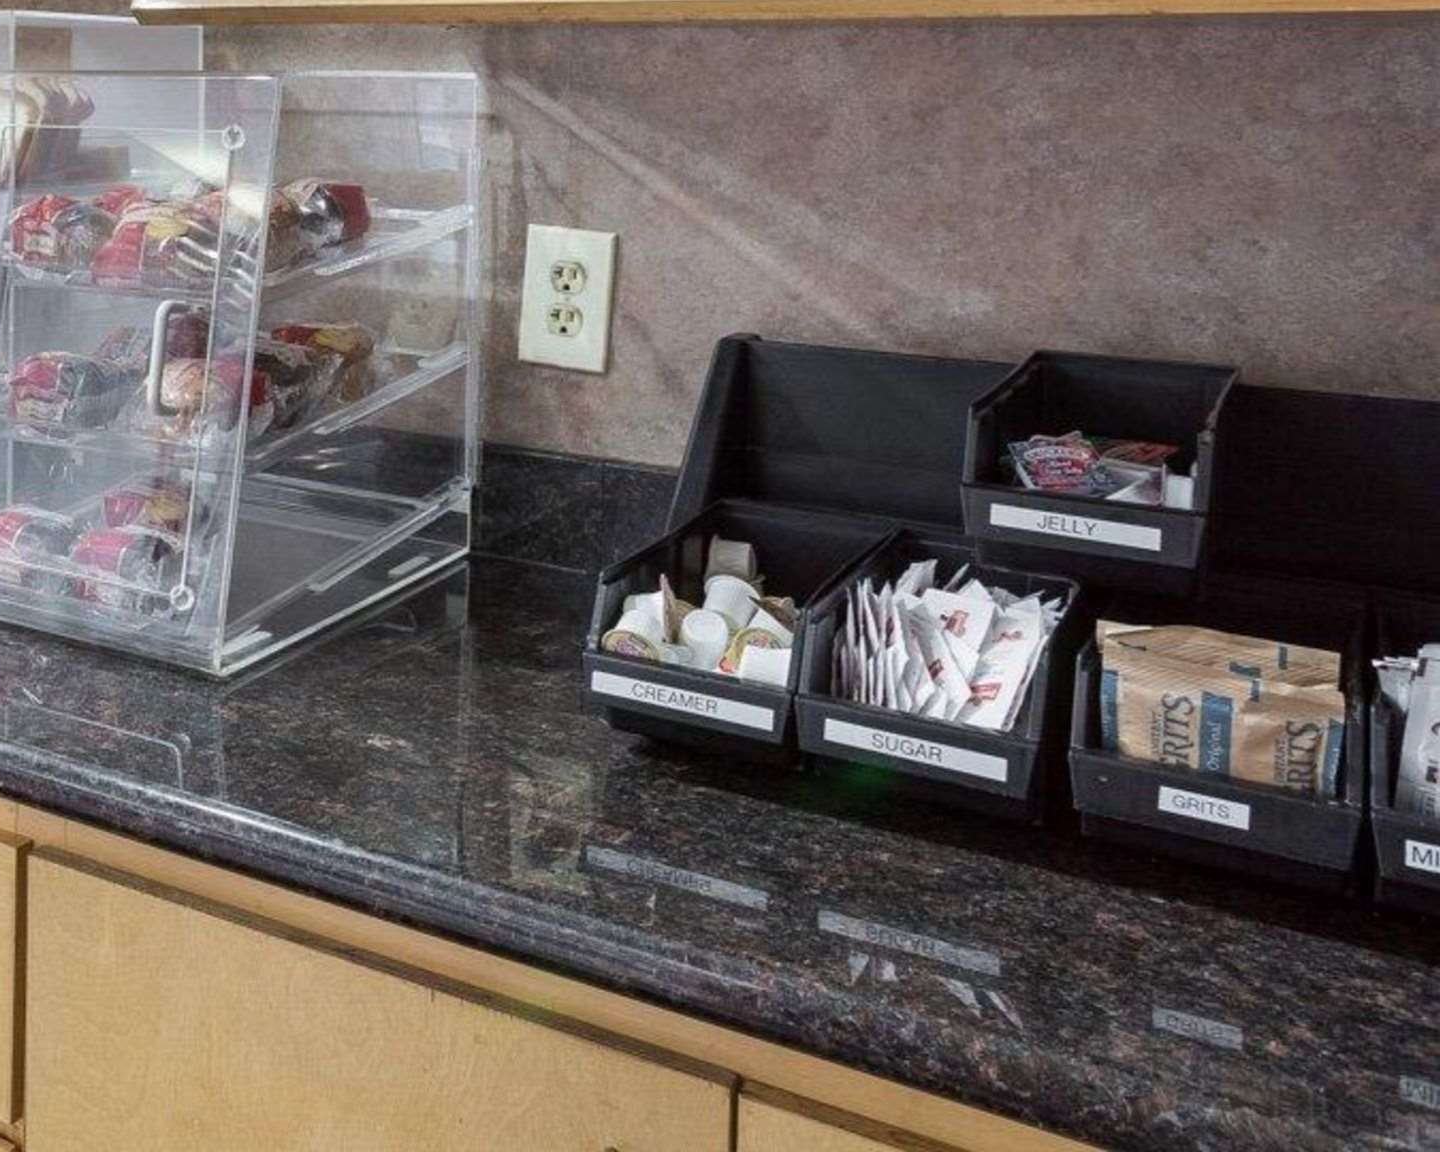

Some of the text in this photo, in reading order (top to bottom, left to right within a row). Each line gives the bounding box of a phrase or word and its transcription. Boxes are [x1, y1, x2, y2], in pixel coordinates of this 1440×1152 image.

[1037, 514, 1096, 537] JELLY
[633, 682, 718, 714] CREAMER
[871, 732, 943, 762] SUGAR
[1286, 721, 1320, 791] RITS
[1172, 795, 1231, 820] GRITS
